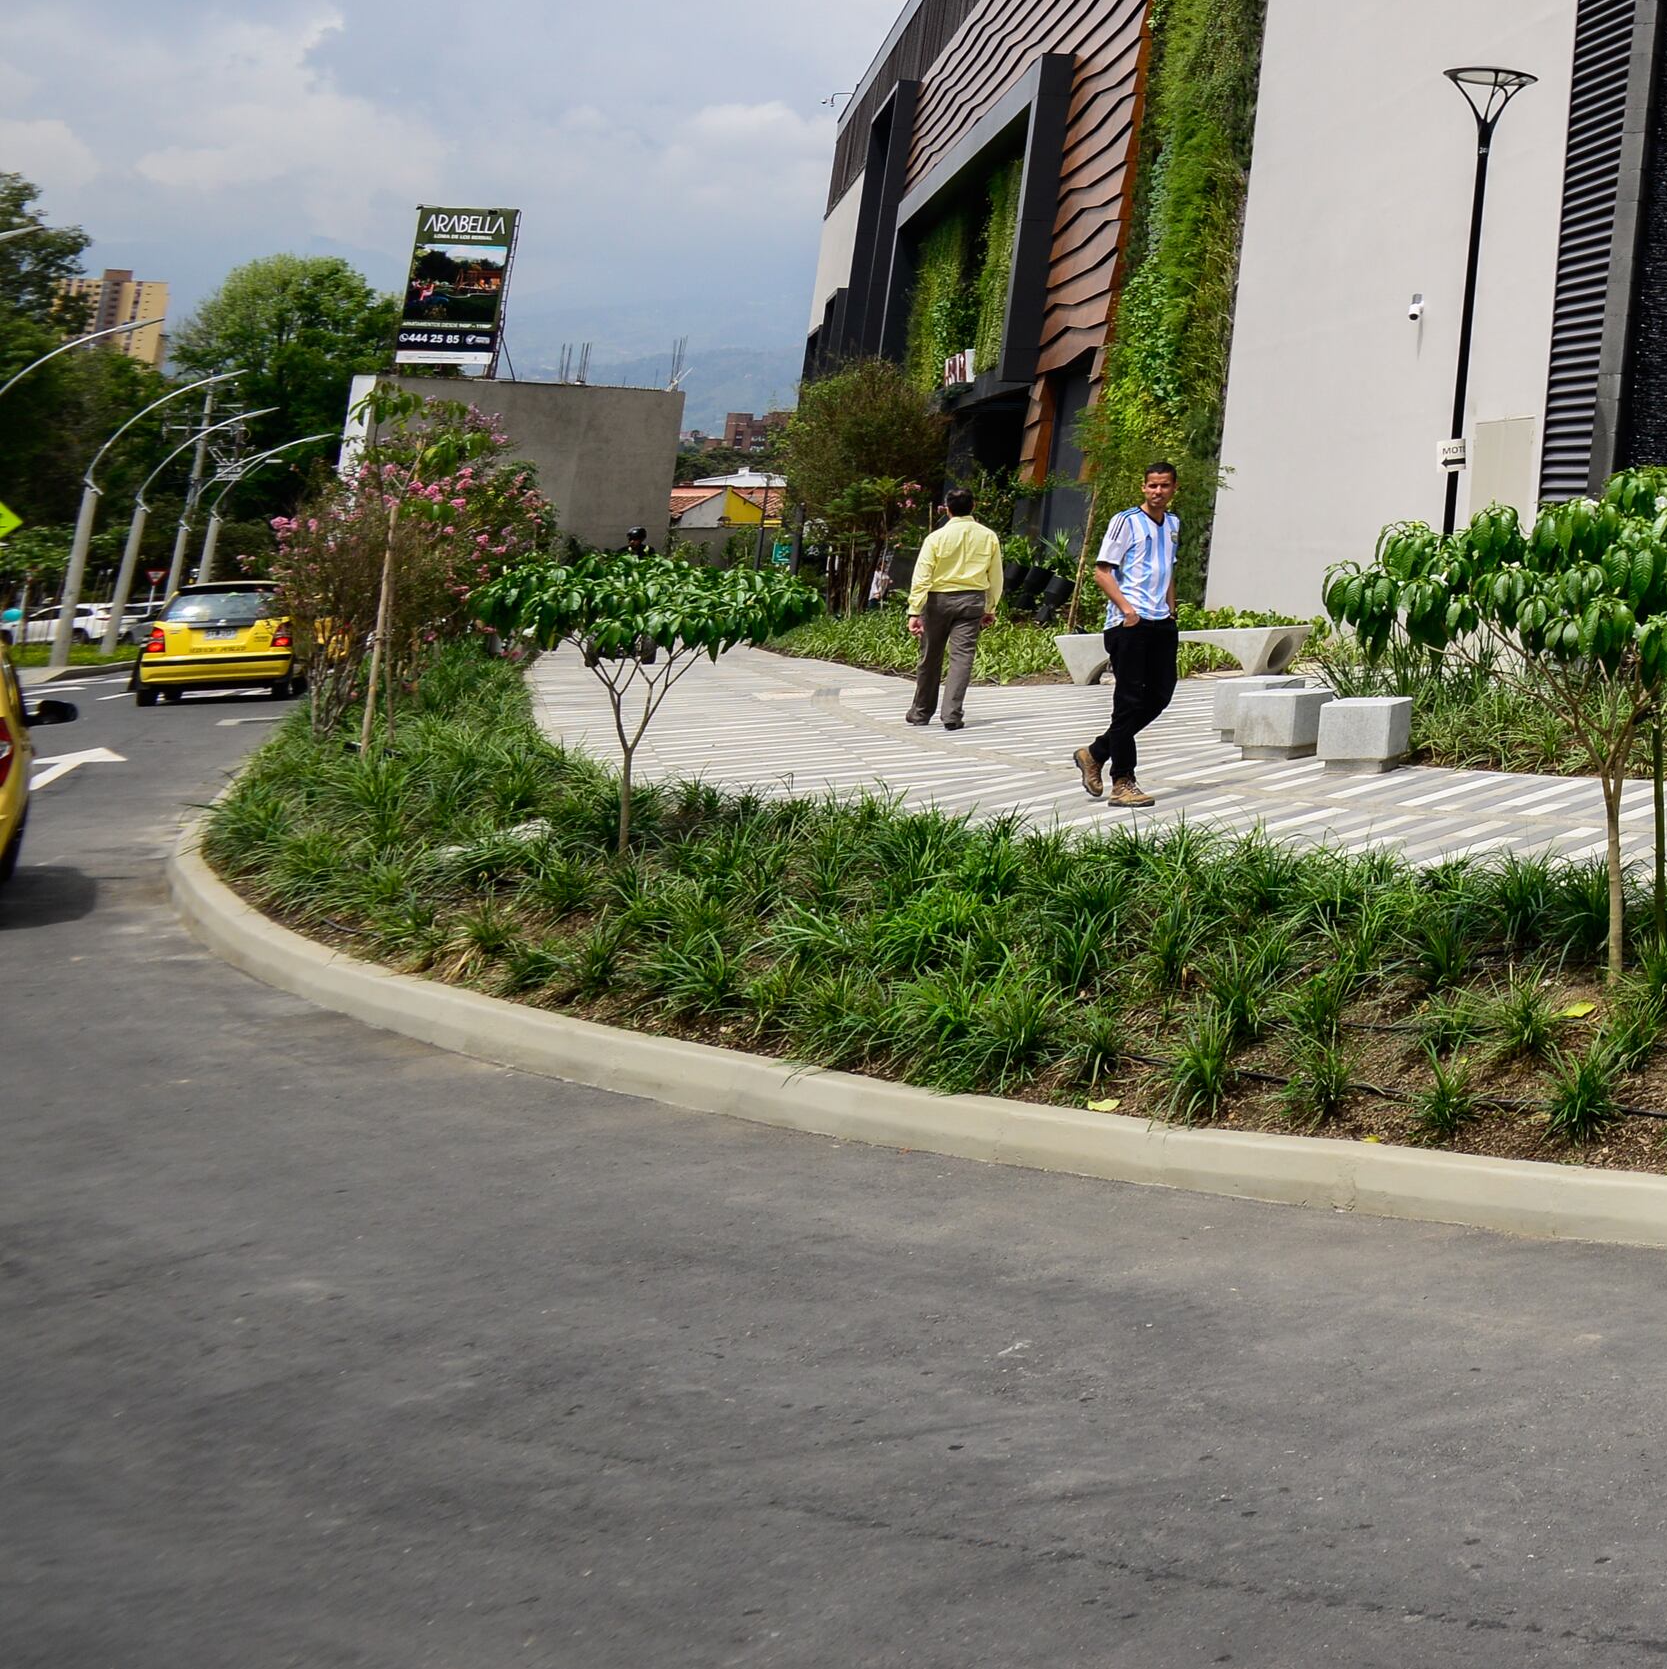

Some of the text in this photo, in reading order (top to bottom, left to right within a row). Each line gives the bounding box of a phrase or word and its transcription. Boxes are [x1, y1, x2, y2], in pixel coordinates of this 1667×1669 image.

[423, 214, 505, 235] ARABELLA
[408, 333, 460, 344] 444 25 85
